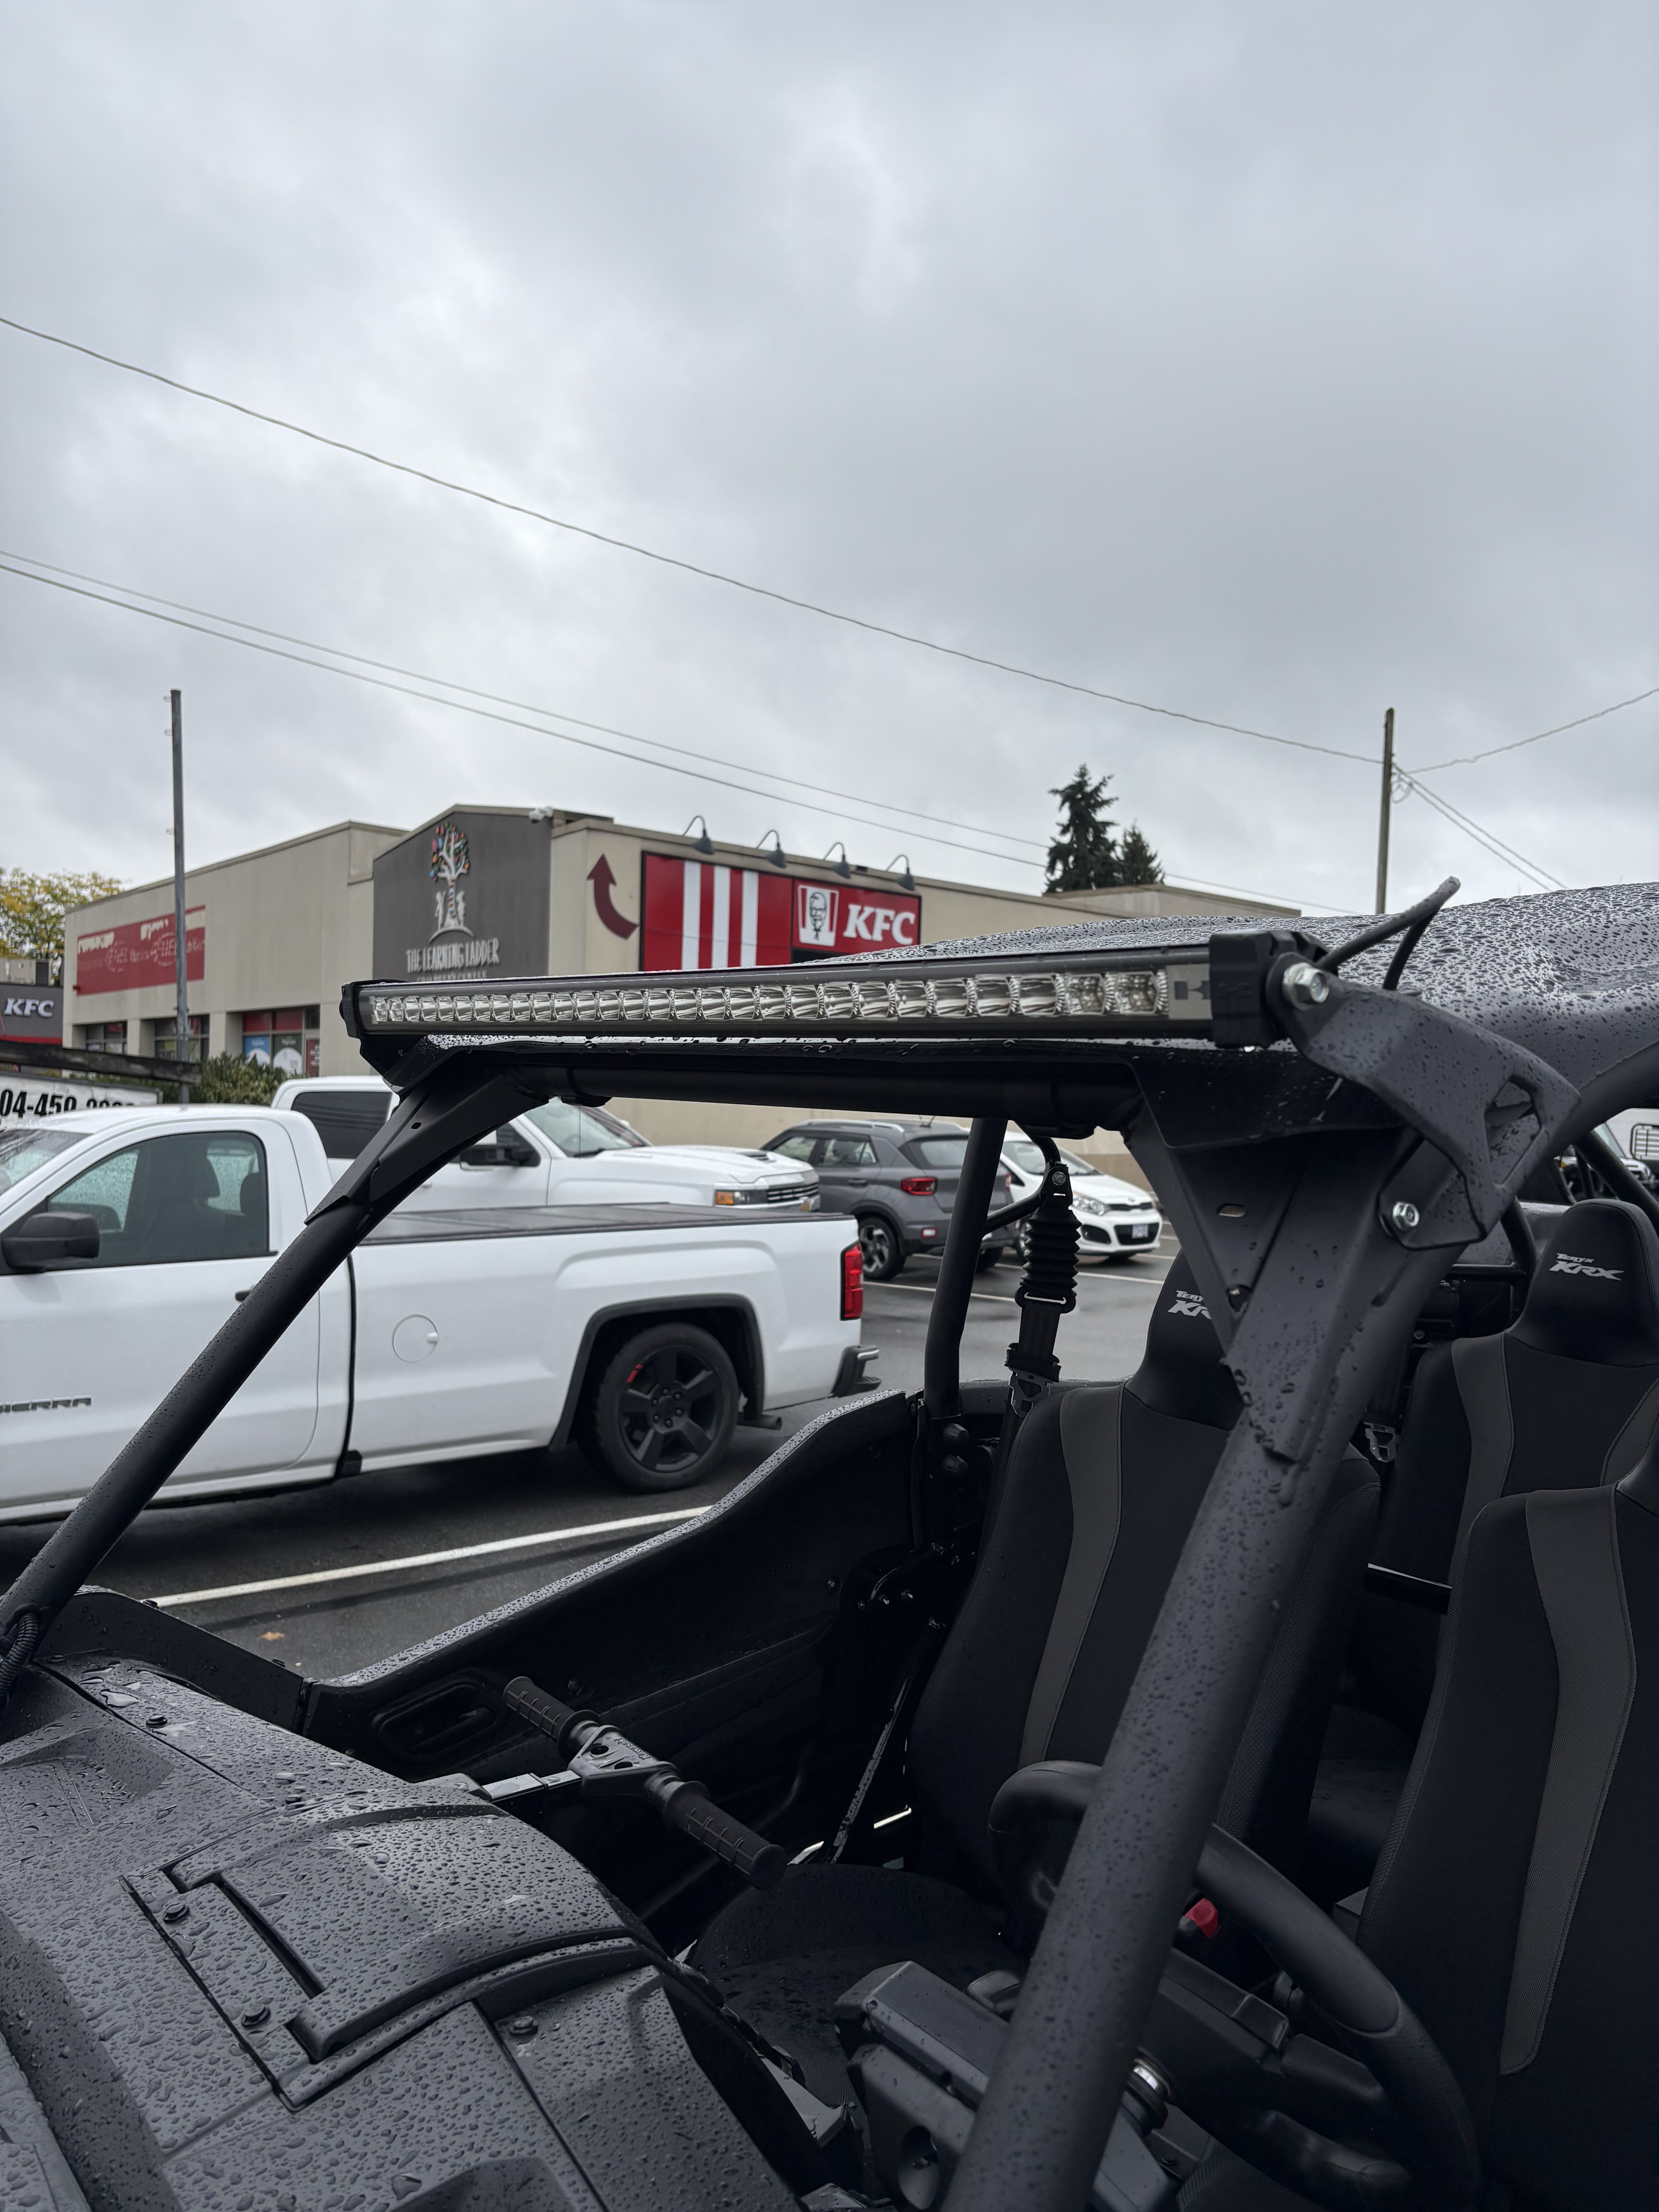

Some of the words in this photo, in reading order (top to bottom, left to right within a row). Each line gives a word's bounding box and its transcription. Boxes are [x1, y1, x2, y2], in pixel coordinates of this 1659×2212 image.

[843, 903, 915, 945] KFC
[406, 948, 422, 973] THE
[422, 943, 464, 970] LEARNING
[465, 937, 500, 967] LADDER
[3, 998, 54, 1017] KFC
[1549, 1260, 1625, 1281] KRX
[1168, 1299, 1212, 1319] KR
[0, 1395, 91, 1413] IERRA
[613, 1738, 651, 1760] Kawasaki
